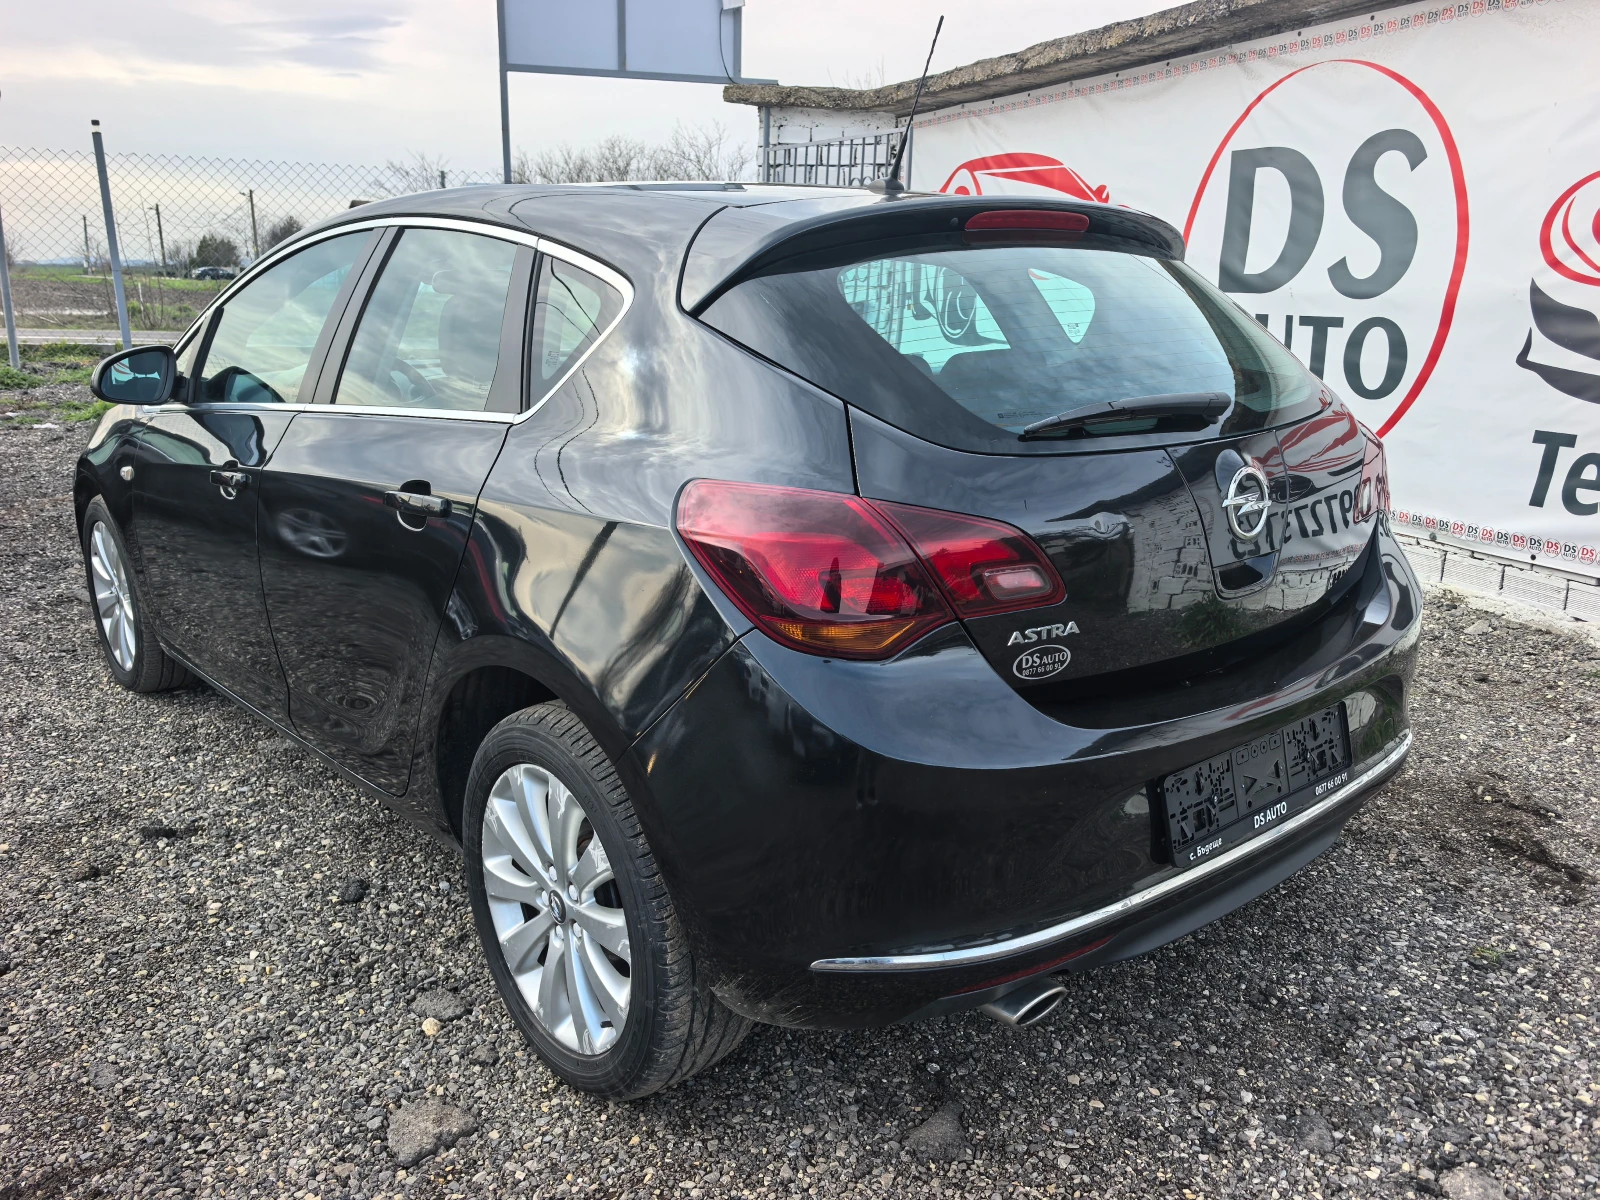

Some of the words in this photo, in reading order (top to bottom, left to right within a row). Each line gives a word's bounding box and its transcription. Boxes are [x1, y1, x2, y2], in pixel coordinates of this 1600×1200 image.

[1472, 1, 1484, 9] DS
[1218, 128, 1428, 300] DS
[1399, 512, 1409, 520] DS
[1425, 517, 1435, 525] DS
[1440, 520, 1449, 528] DS
[1453, 523, 1464, 531] DS
[1468, 526, 1478, 534] DS
[1482, 529, 1492, 538] DS
[1497, 532, 1508, 540] DS
[1513, 535, 1525, 543] DS
[1530, 538, 1542, 547] DS
[1546, 541, 1559, 550] DS
[1564, 544, 1576, 553] DS
[1582, 548, 1594, 557] DS
[1007, 620, 1080, 646] ASTRA
[1022, 654, 1040, 668] DS
[1042, 652, 1067, 664] AUTO
[1022, 667, 1036, 676] 0877
[1055, 662, 1061, 670] 91
[1315, 782, 1327, 796] 0877
[1328, 779, 1334, 790] 66
[1334, 775, 1341, 786] 00
[1342, 772, 1348, 782] 91
[1254, 812, 1265, 829] DS
[1266, 802, 1287, 822] AUTO
